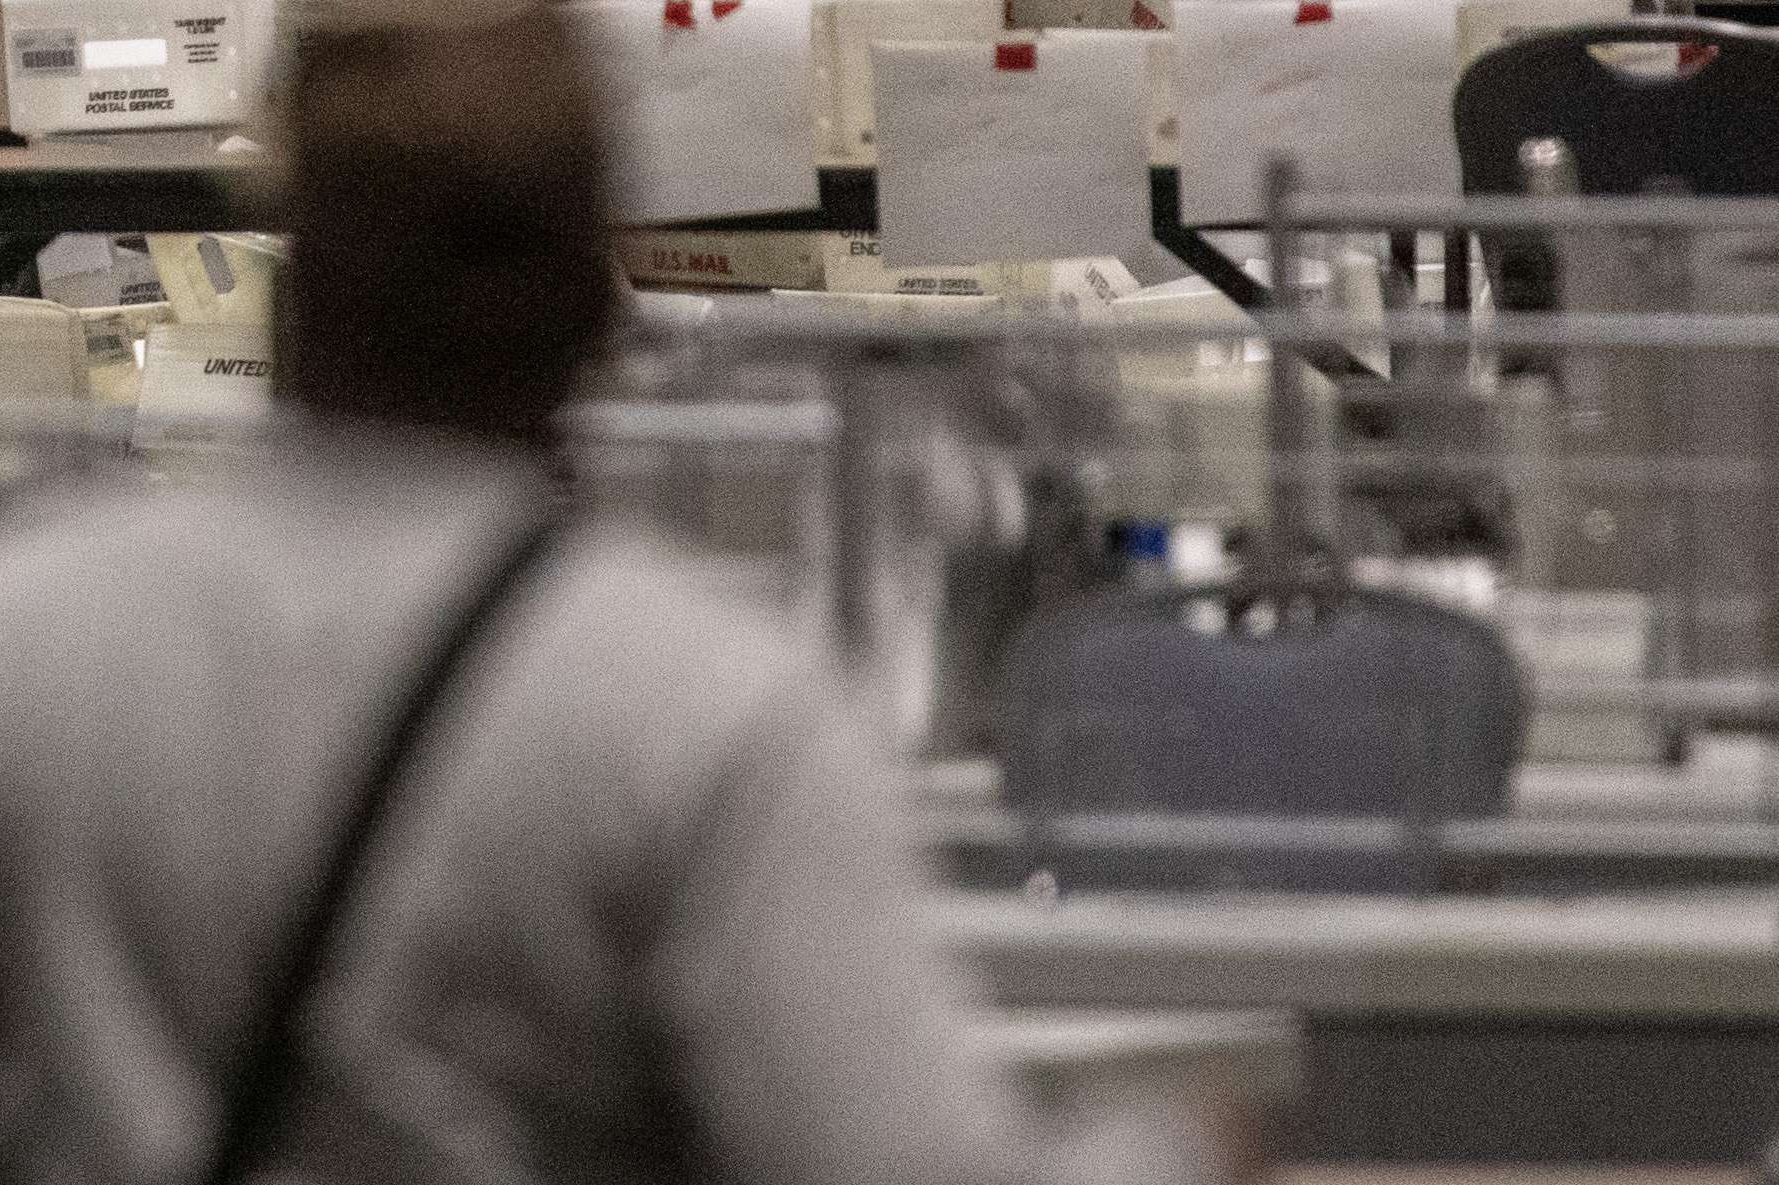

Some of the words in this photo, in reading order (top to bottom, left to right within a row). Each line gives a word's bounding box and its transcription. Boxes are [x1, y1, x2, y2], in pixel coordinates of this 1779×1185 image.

[88, 91, 127, 102] UNITED
[129, 88, 170, 100] STATES
[86, 100, 127, 114] POSTAL
[129, 99, 176, 112] SERVICE
[204, 358, 269, 377] UNITED
